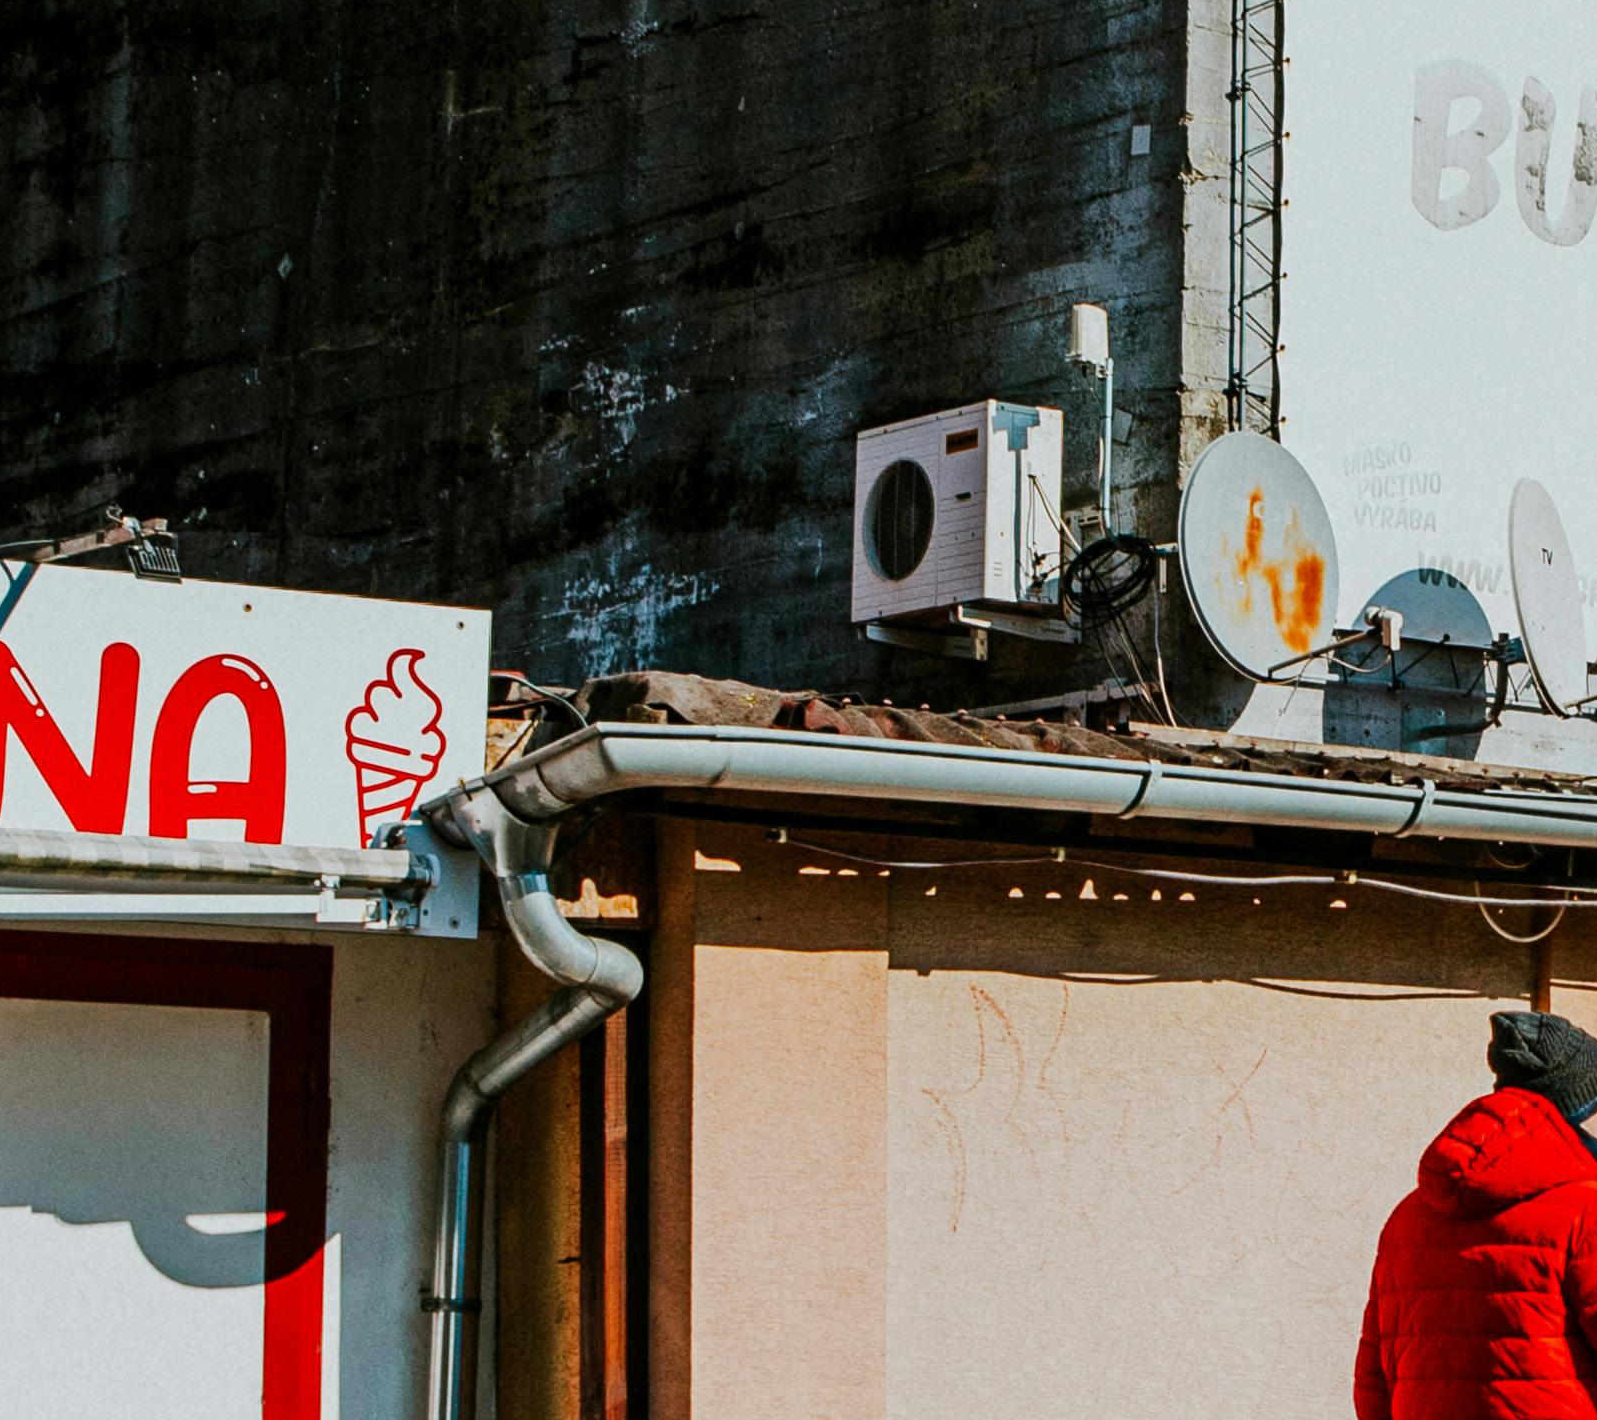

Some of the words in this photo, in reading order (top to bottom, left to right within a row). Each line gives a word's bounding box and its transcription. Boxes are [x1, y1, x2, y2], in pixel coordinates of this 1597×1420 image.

[1357, 471, 1442, 500] POCTIVO
[1354, 499, 1436, 533] VYRÁBA
[1541, 547, 1554, 566] TV
